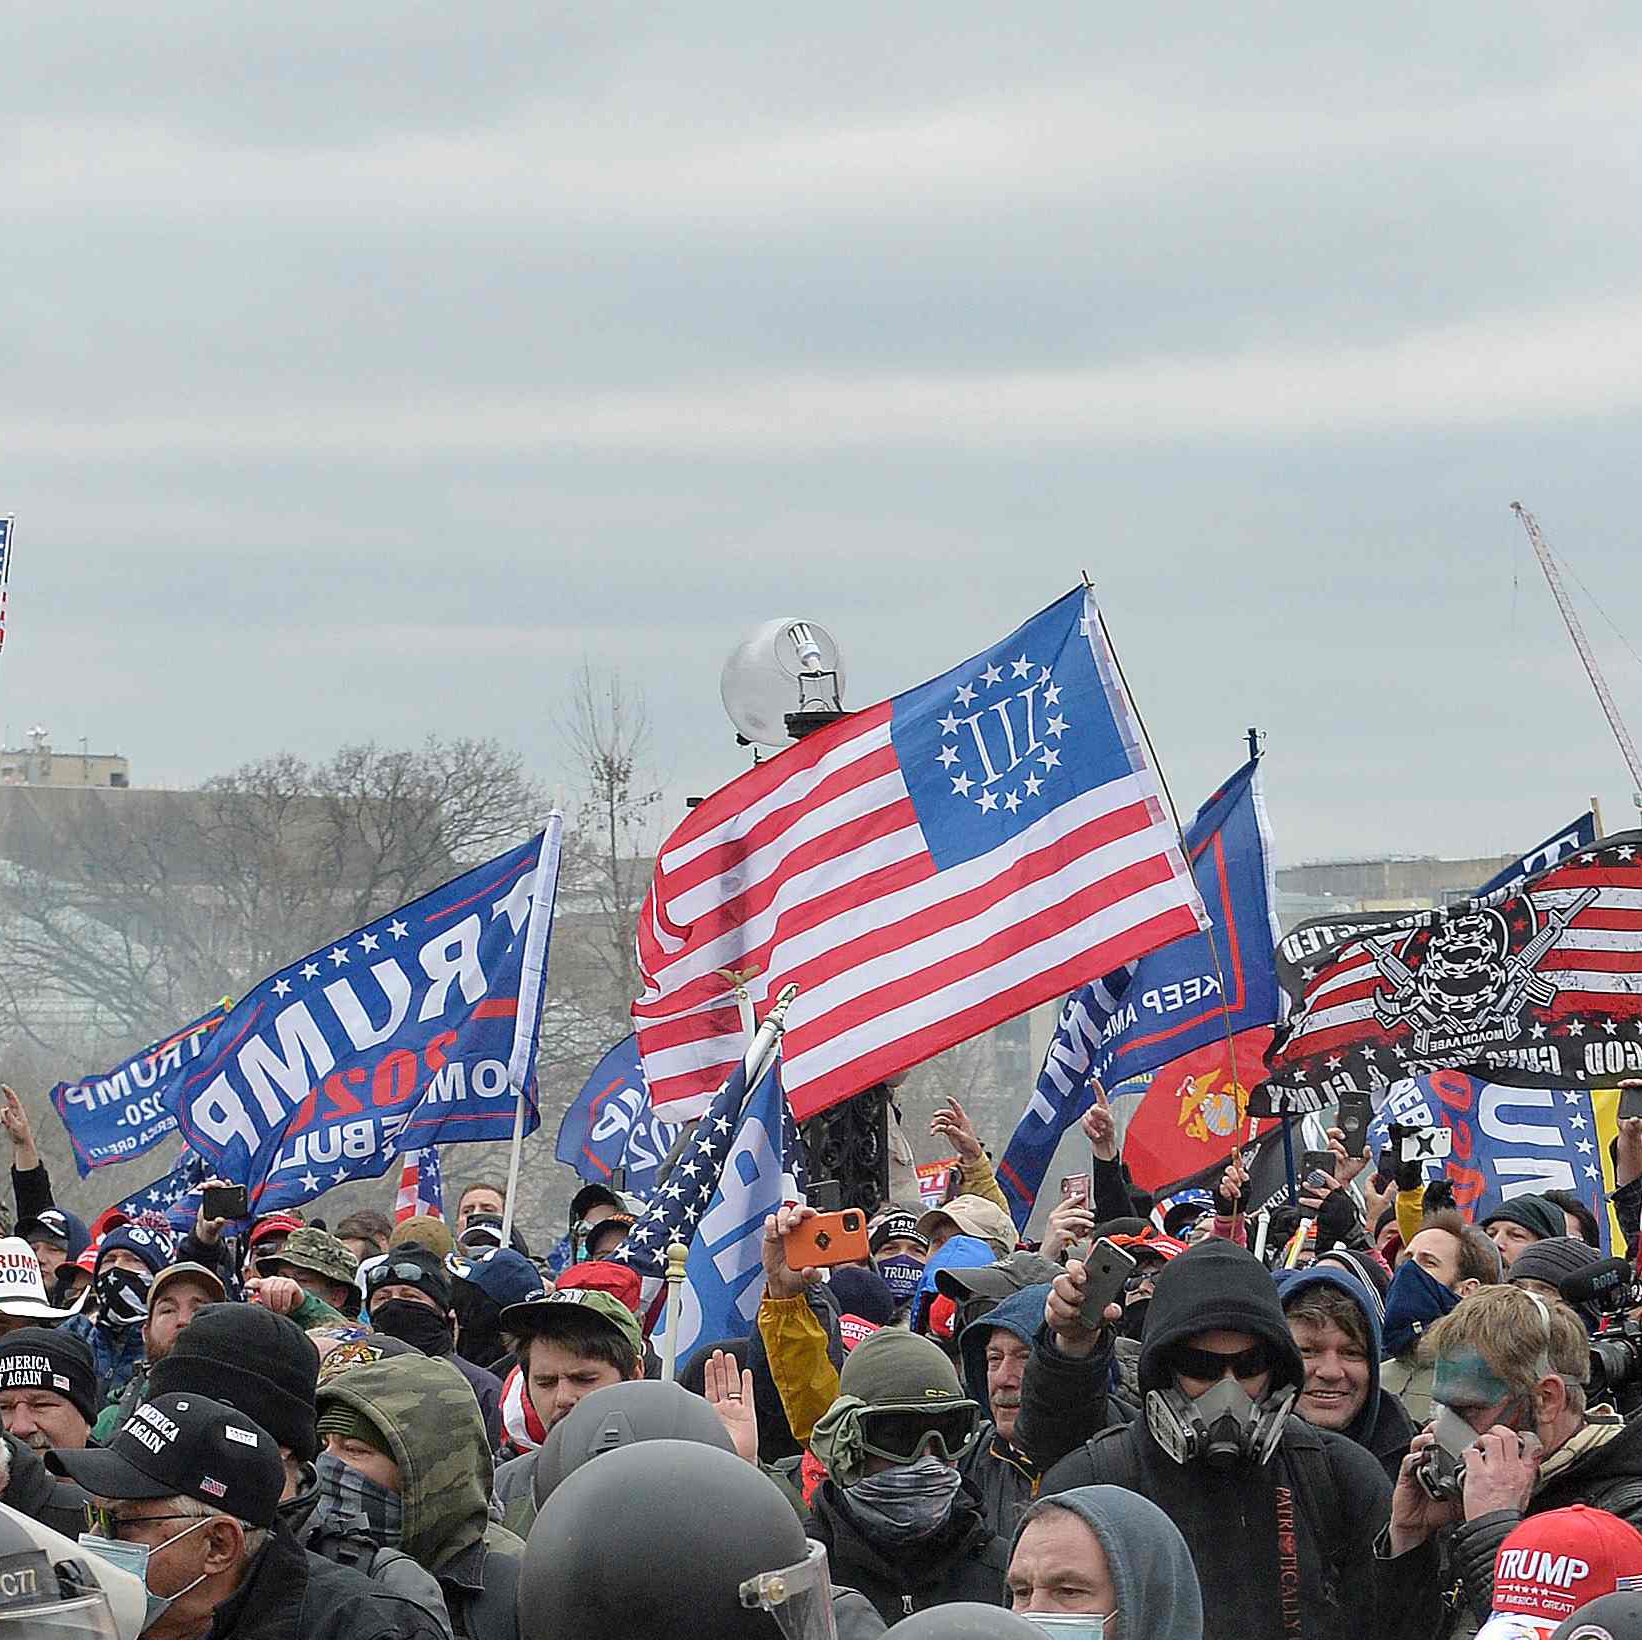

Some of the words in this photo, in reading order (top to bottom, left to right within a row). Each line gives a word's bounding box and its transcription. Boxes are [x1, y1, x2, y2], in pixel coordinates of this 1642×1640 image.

[884, 1266, 923, 1282] TRUMP
[6, 1371, 43, 1387] AGAIN
[128, 1421, 168, 1455] AGAIN
[1497, 1549, 1589, 1588] TRUMP
